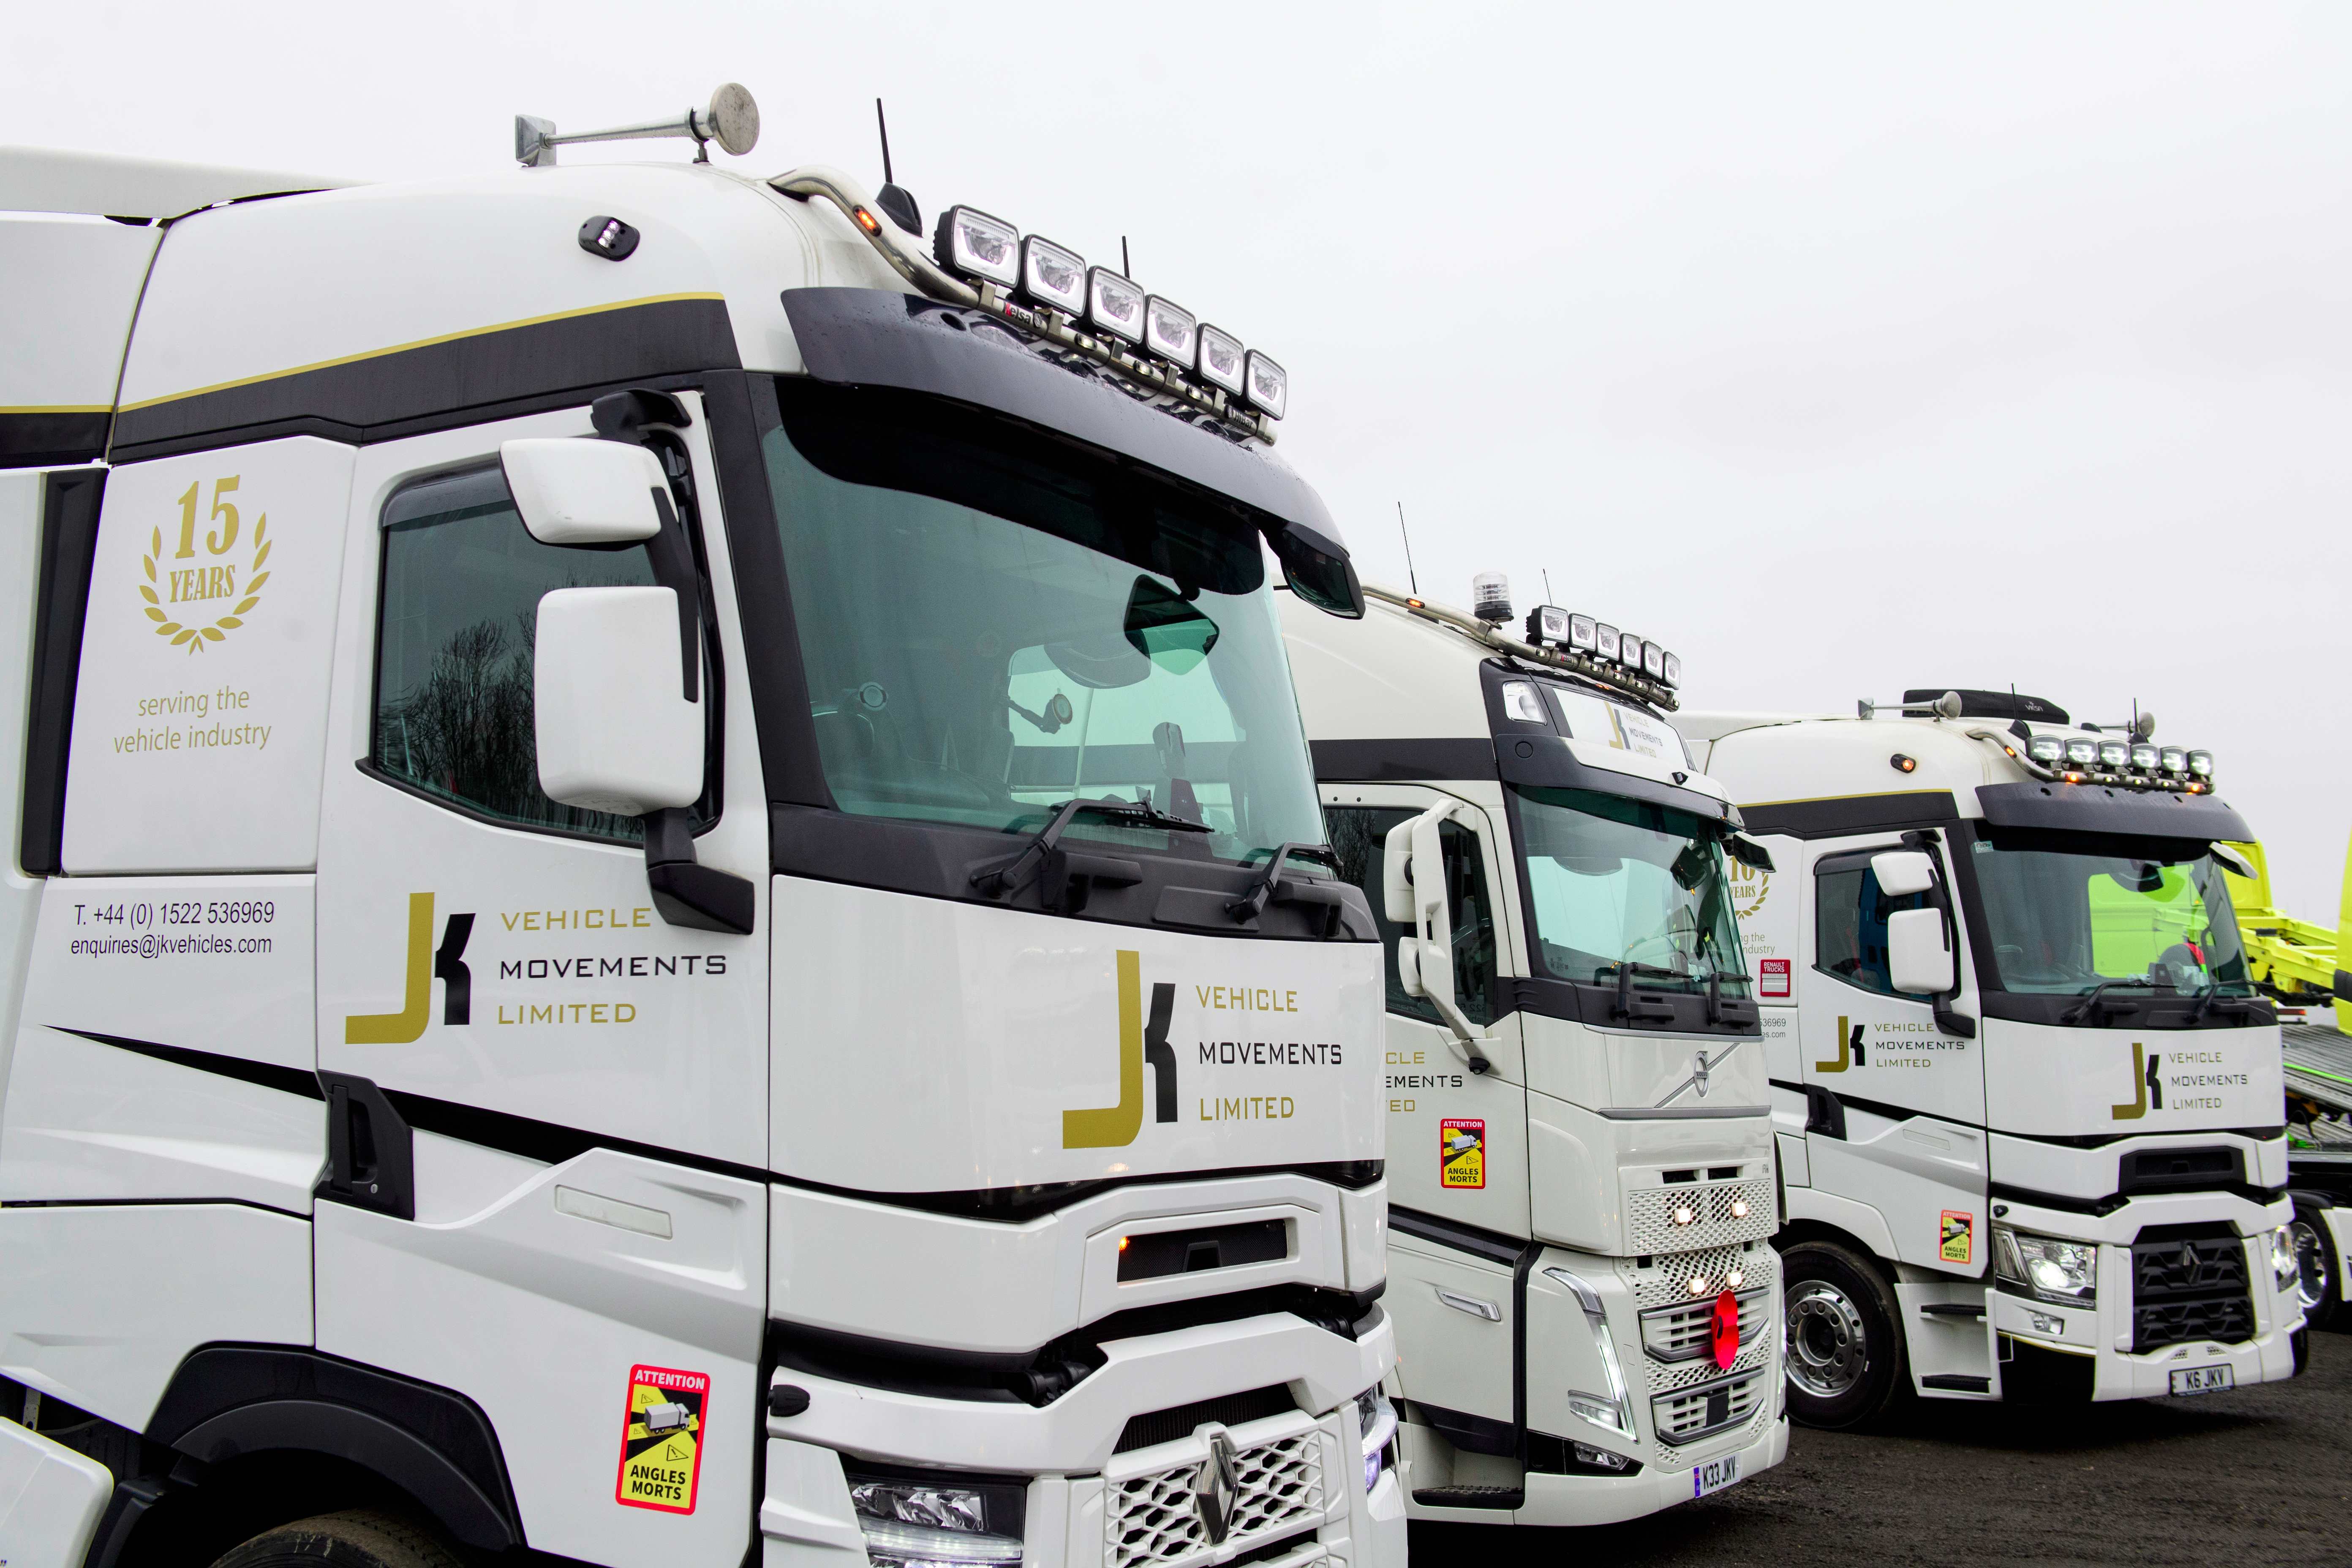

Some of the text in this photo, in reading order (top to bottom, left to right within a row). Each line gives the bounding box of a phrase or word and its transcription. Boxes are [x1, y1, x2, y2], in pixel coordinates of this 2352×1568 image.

[175, 475, 240, 559] 15
[169, 564, 236, 603] YEARS
[138, 686, 249, 718] serving the
[1623, 712, 1649, 727] VEHICLE
[114, 723, 271, 753] vehicle industry
[1629, 727, 1663, 746] MOVEMENTS
[1634, 744, 1656, 757] LIMITED
[74, 901, 274, 930] T. +44 (0) 1522 536969
[501, 907, 651, 932] VEHICLE
[71, 934, 272, 959] enquiries@jkvehicles.com
[1751, 932, 1765, 942] the
[500, 955, 727, 980] MOVEMENTS
[1196, 985, 1298, 1012] VEHICLE
[498, 1003, 637, 1025] LIMITED
[1875, 1024, 1934, 1032] VEHICLE
[1199, 1042, 1342, 1065] MOVEMENTS
[1876, 1041, 1965, 1050] MOVEMENTS
[1877, 1059, 1931, 1067] LIMITED
[2169, 1052, 2222, 1063] VEHICLE
[2171, 1074, 2248, 1086] MOVEMENTS
[1200, 1097, 1294, 1121] LIMITED
[2173, 1098, 2221, 1109] LIMITED
[634, 1369, 705, 1390] ATTENTION
[2186, 1368, 2223, 1389] K6 JKV
[630, 1465, 686, 1484] ANGLES
[1703, 1456, 1735, 1489] K33 JKV
[632, 1481, 681, 1500] MORTS
